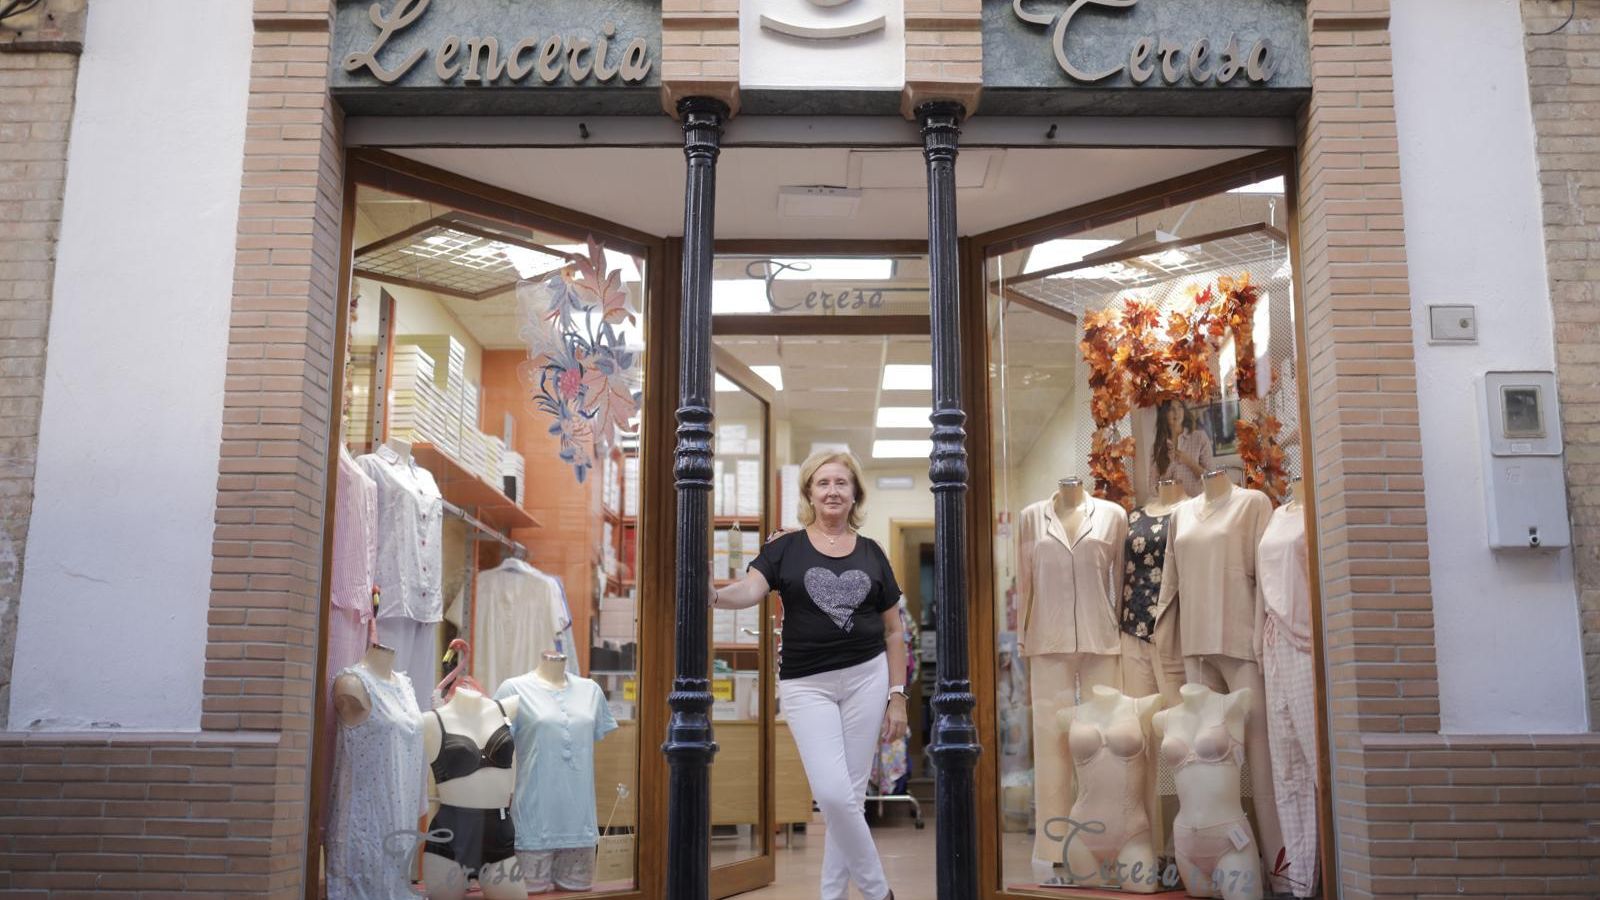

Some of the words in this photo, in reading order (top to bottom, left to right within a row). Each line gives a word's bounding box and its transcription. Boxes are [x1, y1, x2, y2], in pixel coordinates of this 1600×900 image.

[343, 0, 652, 83] Lenceria
[1013, 0, 1277, 83] Teresa
[745, 260, 886, 311] Teresa
[383, 827, 524, 898] Teresa
[1044, 816, 1180, 888] Teresa
